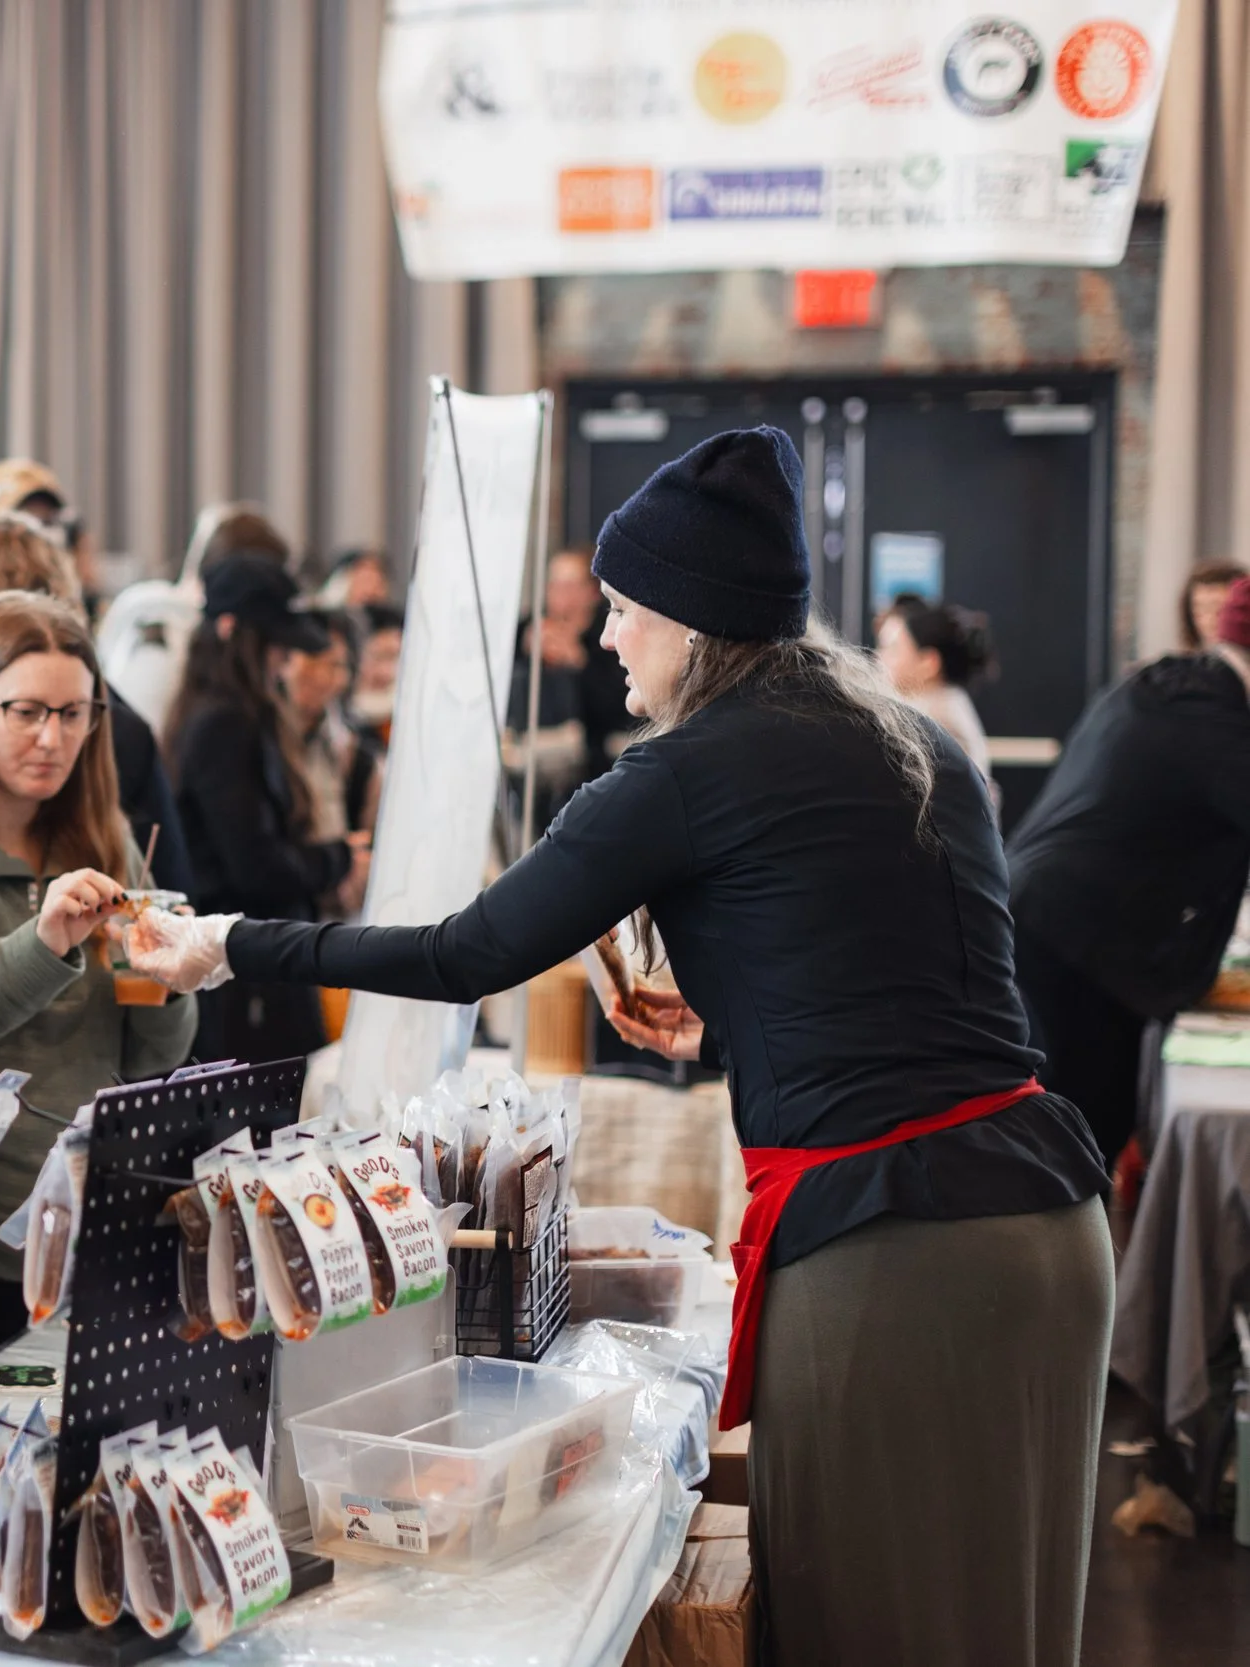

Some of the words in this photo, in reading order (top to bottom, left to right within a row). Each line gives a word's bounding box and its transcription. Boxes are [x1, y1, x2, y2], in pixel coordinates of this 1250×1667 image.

[387, 1218, 429, 1241] Smokey
[320, 1245, 354, 1265] Peppy
[395, 1237, 435, 1259] Savory
[325, 1262, 359, 1286] Pepper
[403, 1256, 437, 1277] Bacon
[331, 1283, 363, 1306] Bacon
[225, 1525, 270, 1558] Smokey
[234, 1545, 275, 1577] Savory
[241, 1566, 279, 1595] Bacon
